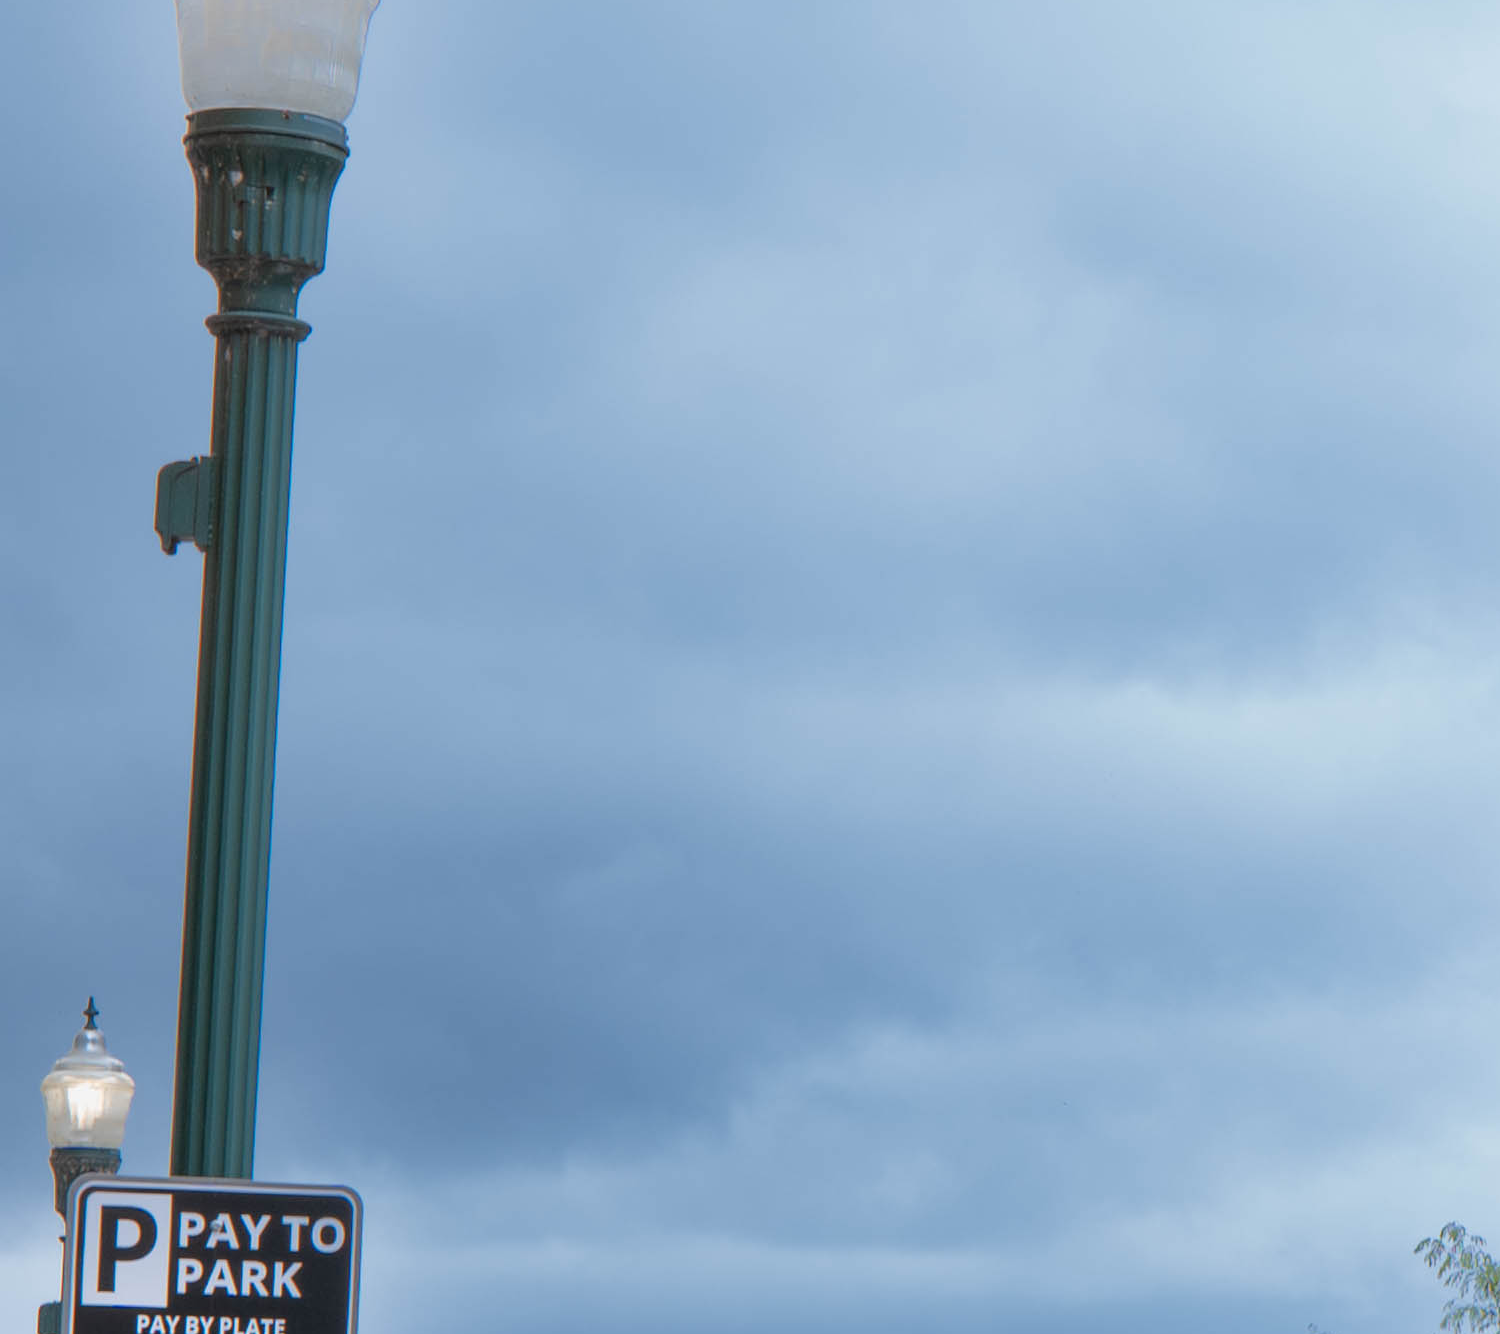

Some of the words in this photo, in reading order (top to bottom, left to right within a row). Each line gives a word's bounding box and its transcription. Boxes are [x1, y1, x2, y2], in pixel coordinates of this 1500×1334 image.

[97, 1205, 158, 1293] P
[178, 1212, 271, 1251] PAY
[282, 1215, 346, 1254] TO
[176, 1258, 303, 1298] PARK
